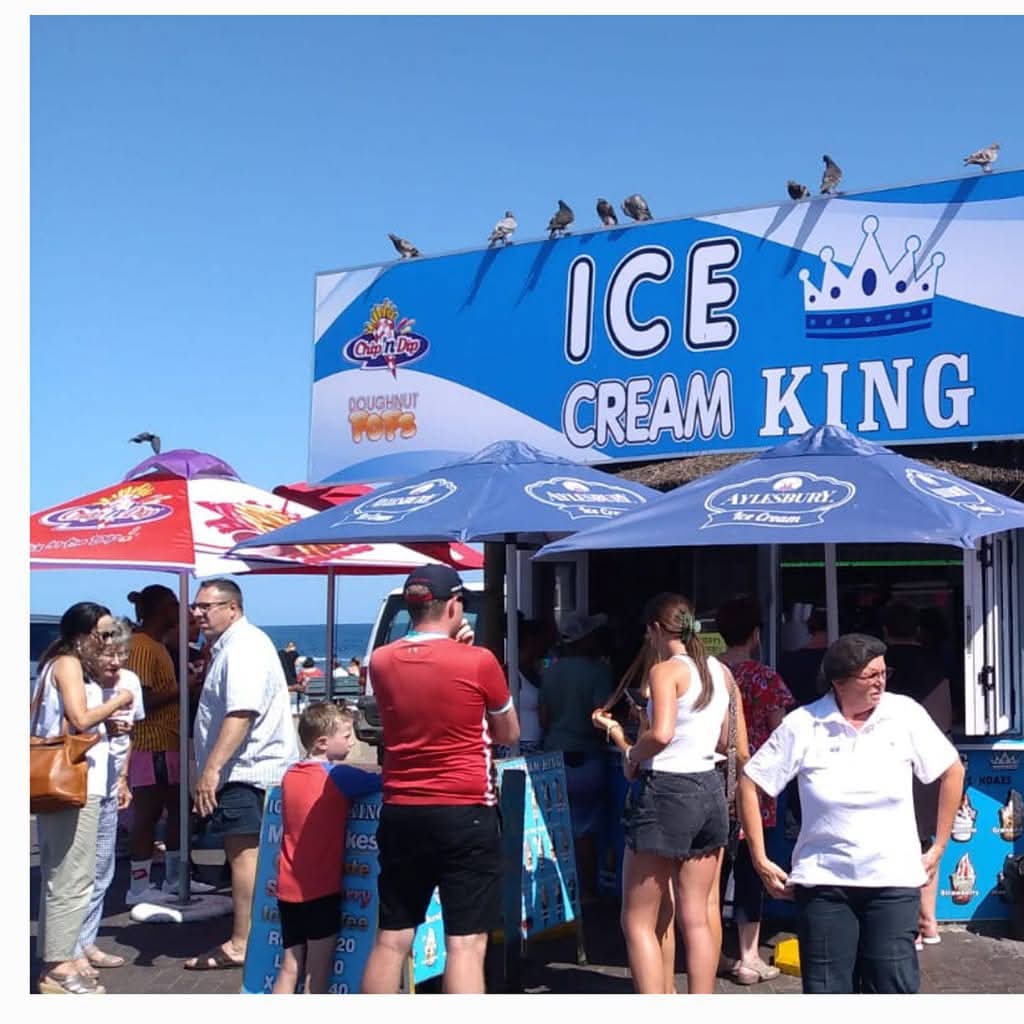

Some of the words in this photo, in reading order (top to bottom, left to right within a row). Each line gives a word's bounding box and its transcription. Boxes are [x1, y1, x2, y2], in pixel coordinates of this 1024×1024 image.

[564, 236, 742, 364] ICE
[348, 392, 419, 412] DOUGHNUT
[561, 368, 736, 450] CREAM
[759, 352, 976, 437] KING
[720, 490, 837, 505] AYLESBURY
